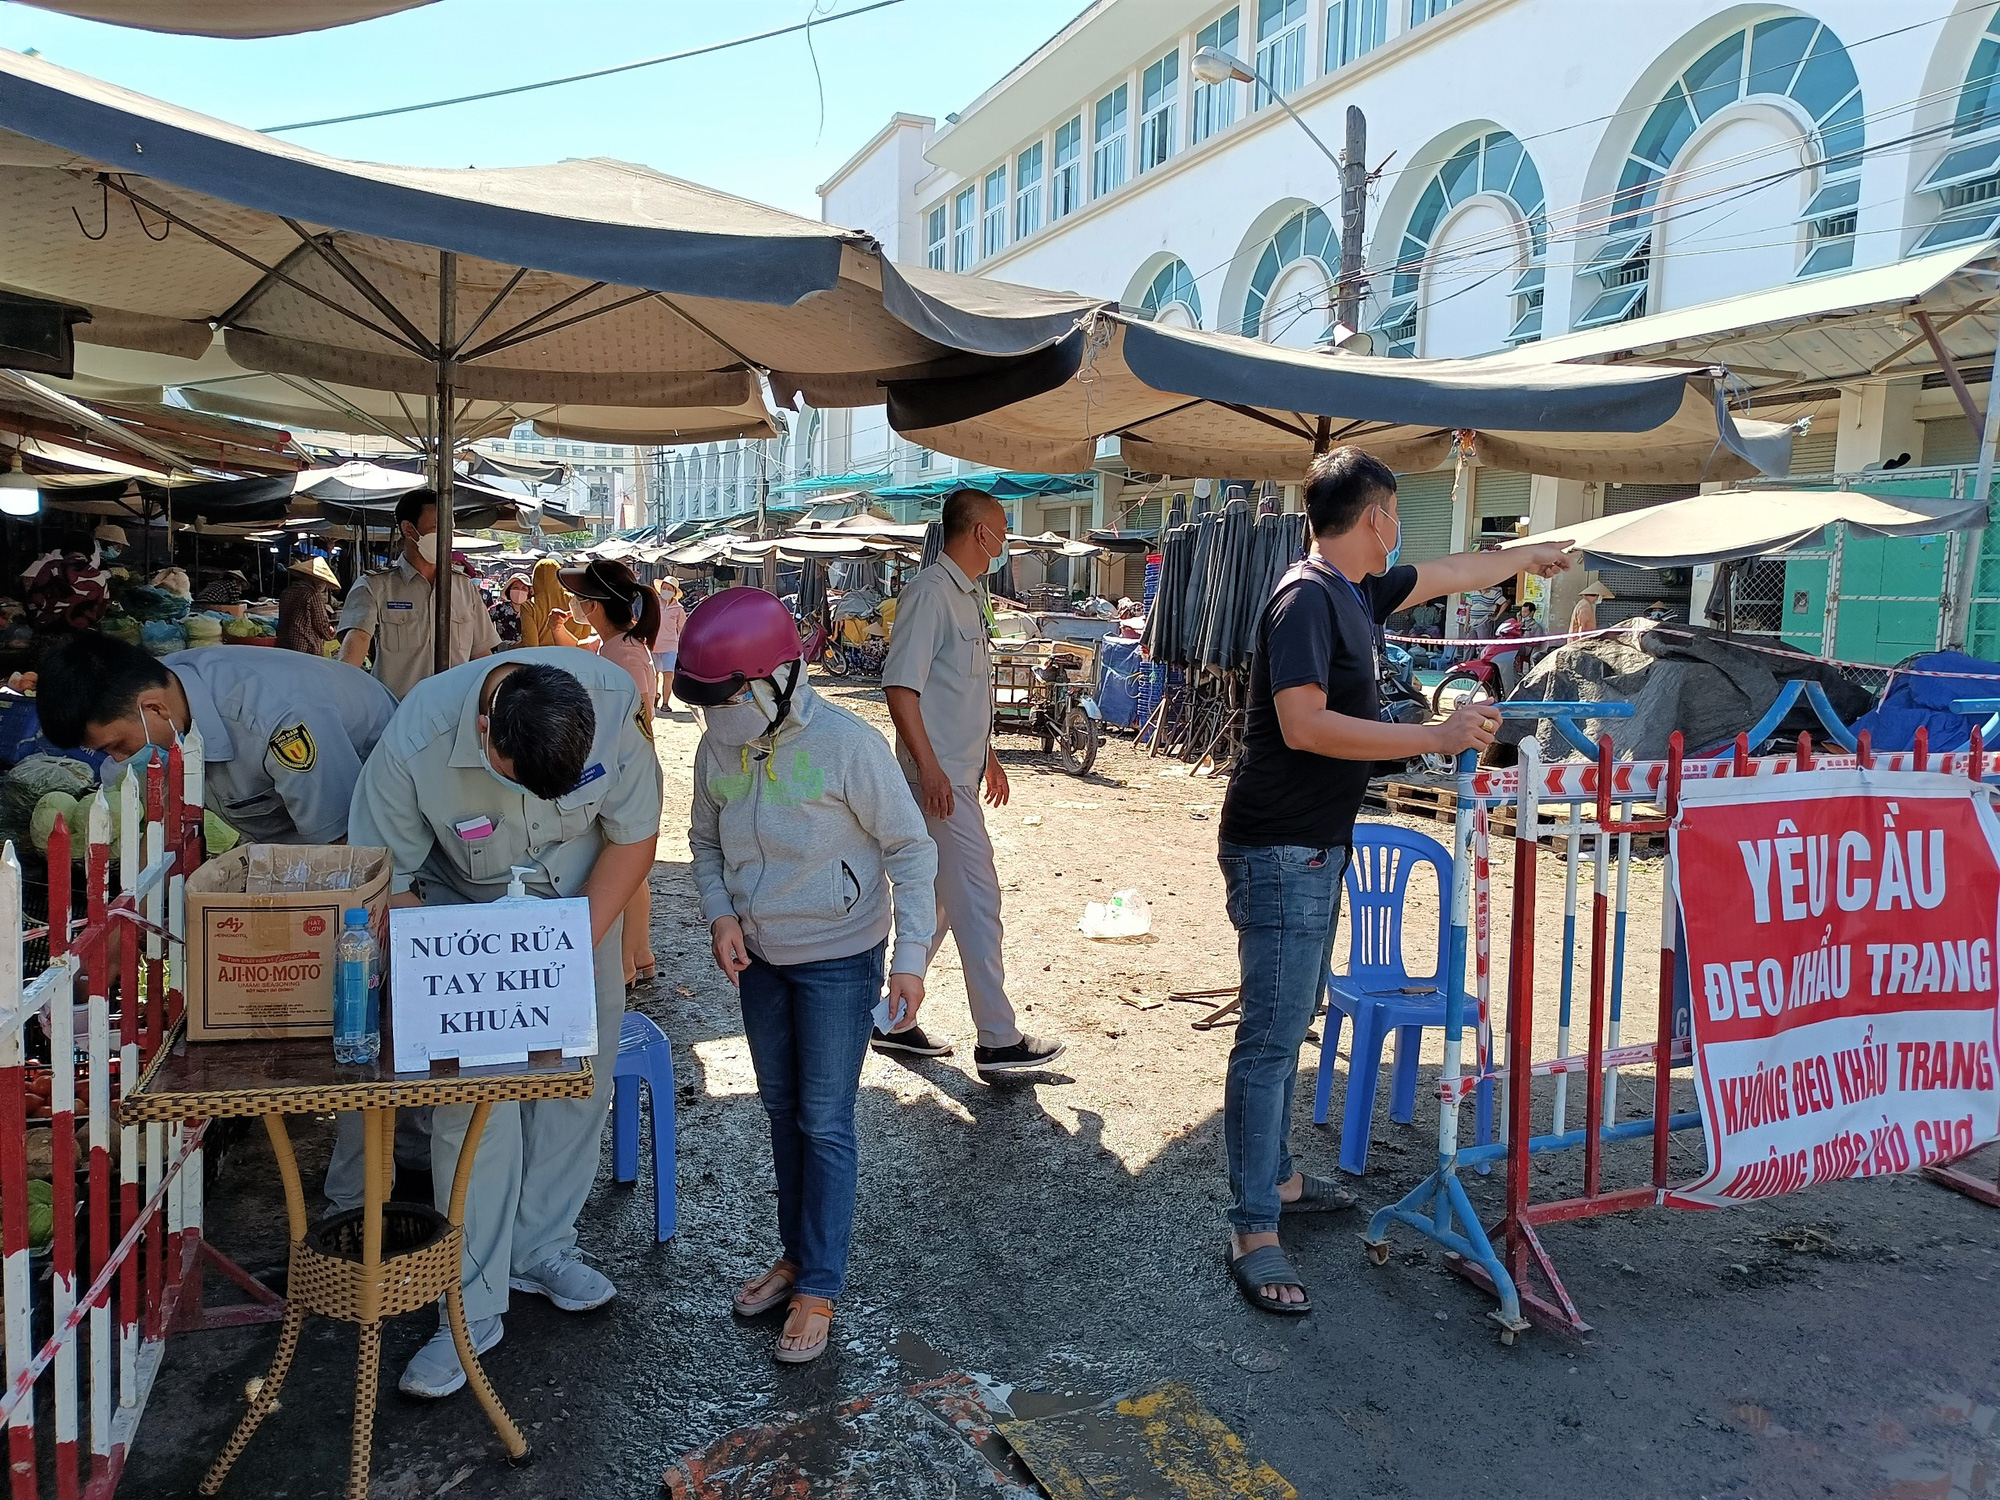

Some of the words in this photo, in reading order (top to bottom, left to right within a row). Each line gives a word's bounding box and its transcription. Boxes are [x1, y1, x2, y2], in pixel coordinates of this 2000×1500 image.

[1737, 818, 1829, 924] YÊU
[1836, 802, 1946, 912] CẦU
[410, 928, 501, 959] NƯỚC
[509, 924, 575, 953] RỬA
[423, 972, 487, 996] TAY
[495, 961, 566, 992] KHỬ
[1703, 957, 1784, 1022] ĐEO
[1787, 923, 1851, 1011] KHẨU
[1866, 937, 1992, 996] TRANG
[1718, 1060, 1790, 1136] KHÔNG
[1791, 1054, 1834, 1117] ĐEO
[1832, 1023, 1889, 1105] KHẨU
[1896, 1040, 1994, 1092] TRANG
